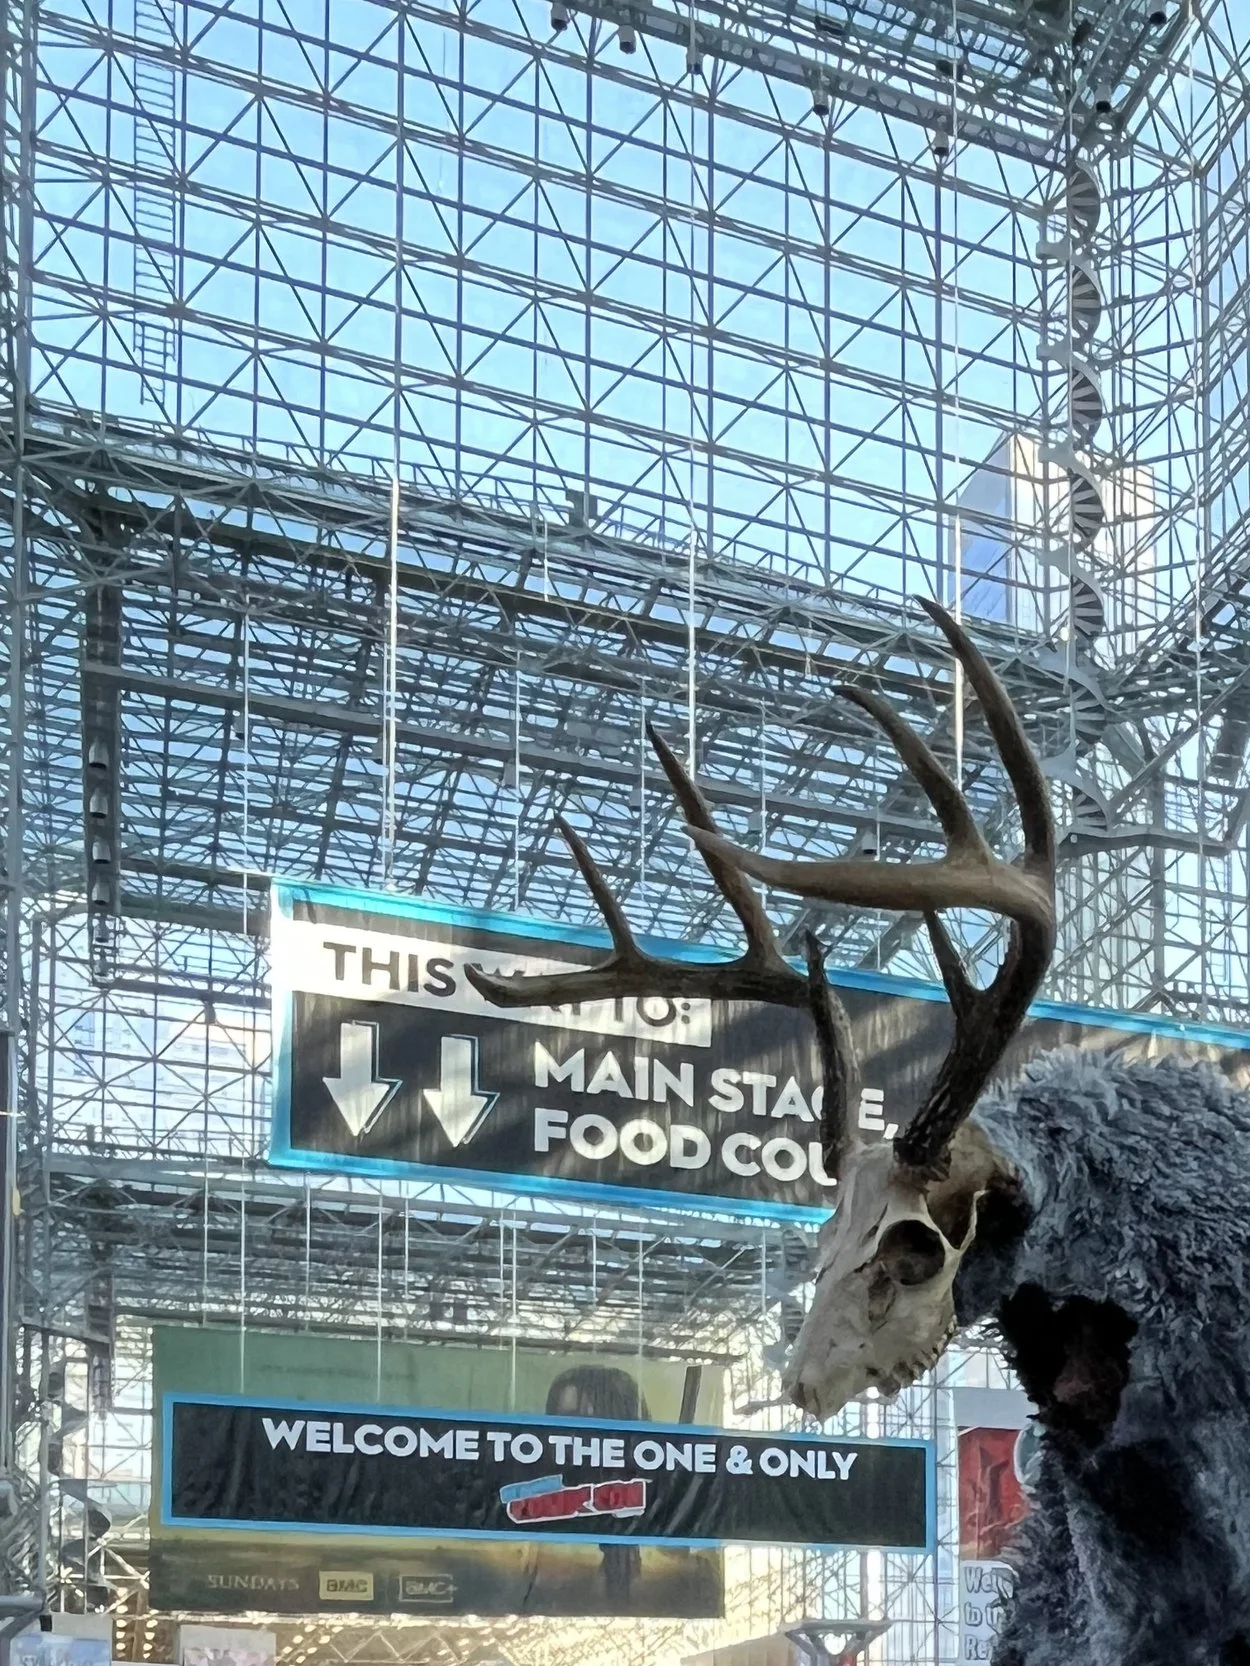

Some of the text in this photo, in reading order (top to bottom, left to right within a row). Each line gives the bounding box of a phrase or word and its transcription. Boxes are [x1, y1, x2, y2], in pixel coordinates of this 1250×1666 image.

[323, 942, 457, 998] THIS
[534, 1040, 695, 1108] MAIN
[534, 1108, 838, 1187] FOOD COU
[262, 1418, 858, 1480] WELCOME TO THE ONE & ONLY
[208, 1574, 300, 1592] SUNDAYS
